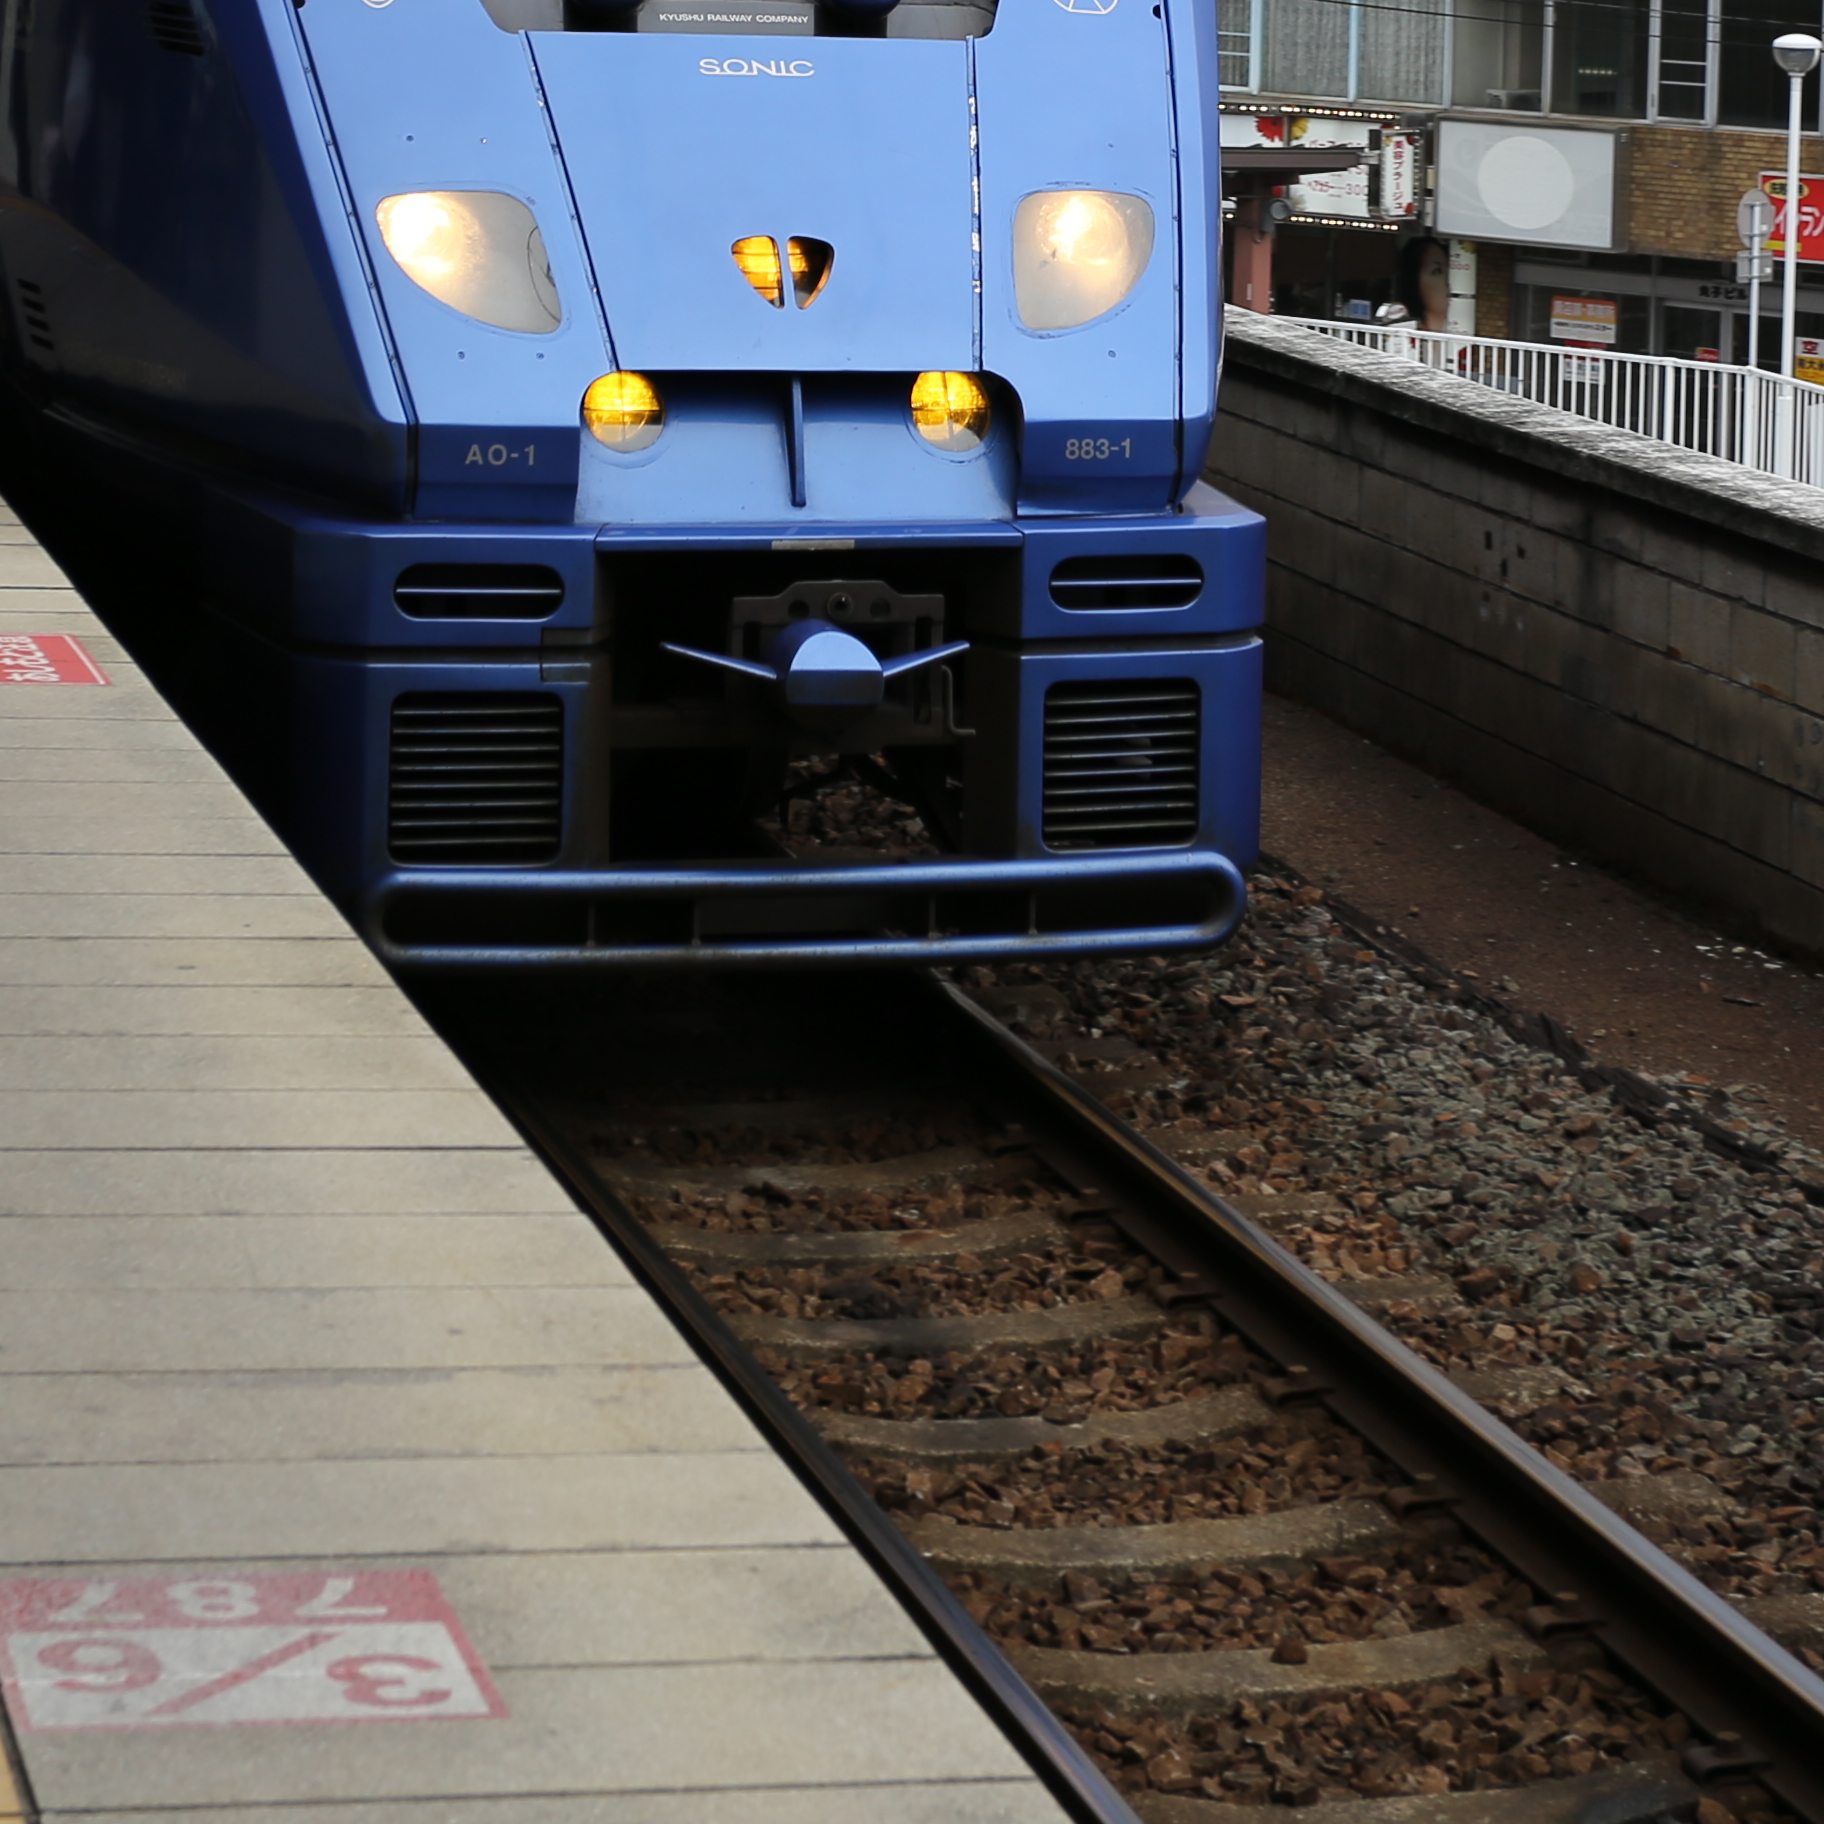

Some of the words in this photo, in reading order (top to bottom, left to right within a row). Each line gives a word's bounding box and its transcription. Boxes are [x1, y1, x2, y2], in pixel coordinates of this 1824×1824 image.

[658, 13, 704, 23] KYUSHU
[707, 14, 753, 24] RAILWAY
[756, 14, 809, 25] COMPANY
[698, 58, 816, 77] SONIC
[464, 444, 537, 466] AO-1
[1064, 438, 1134, 461] 883-1
